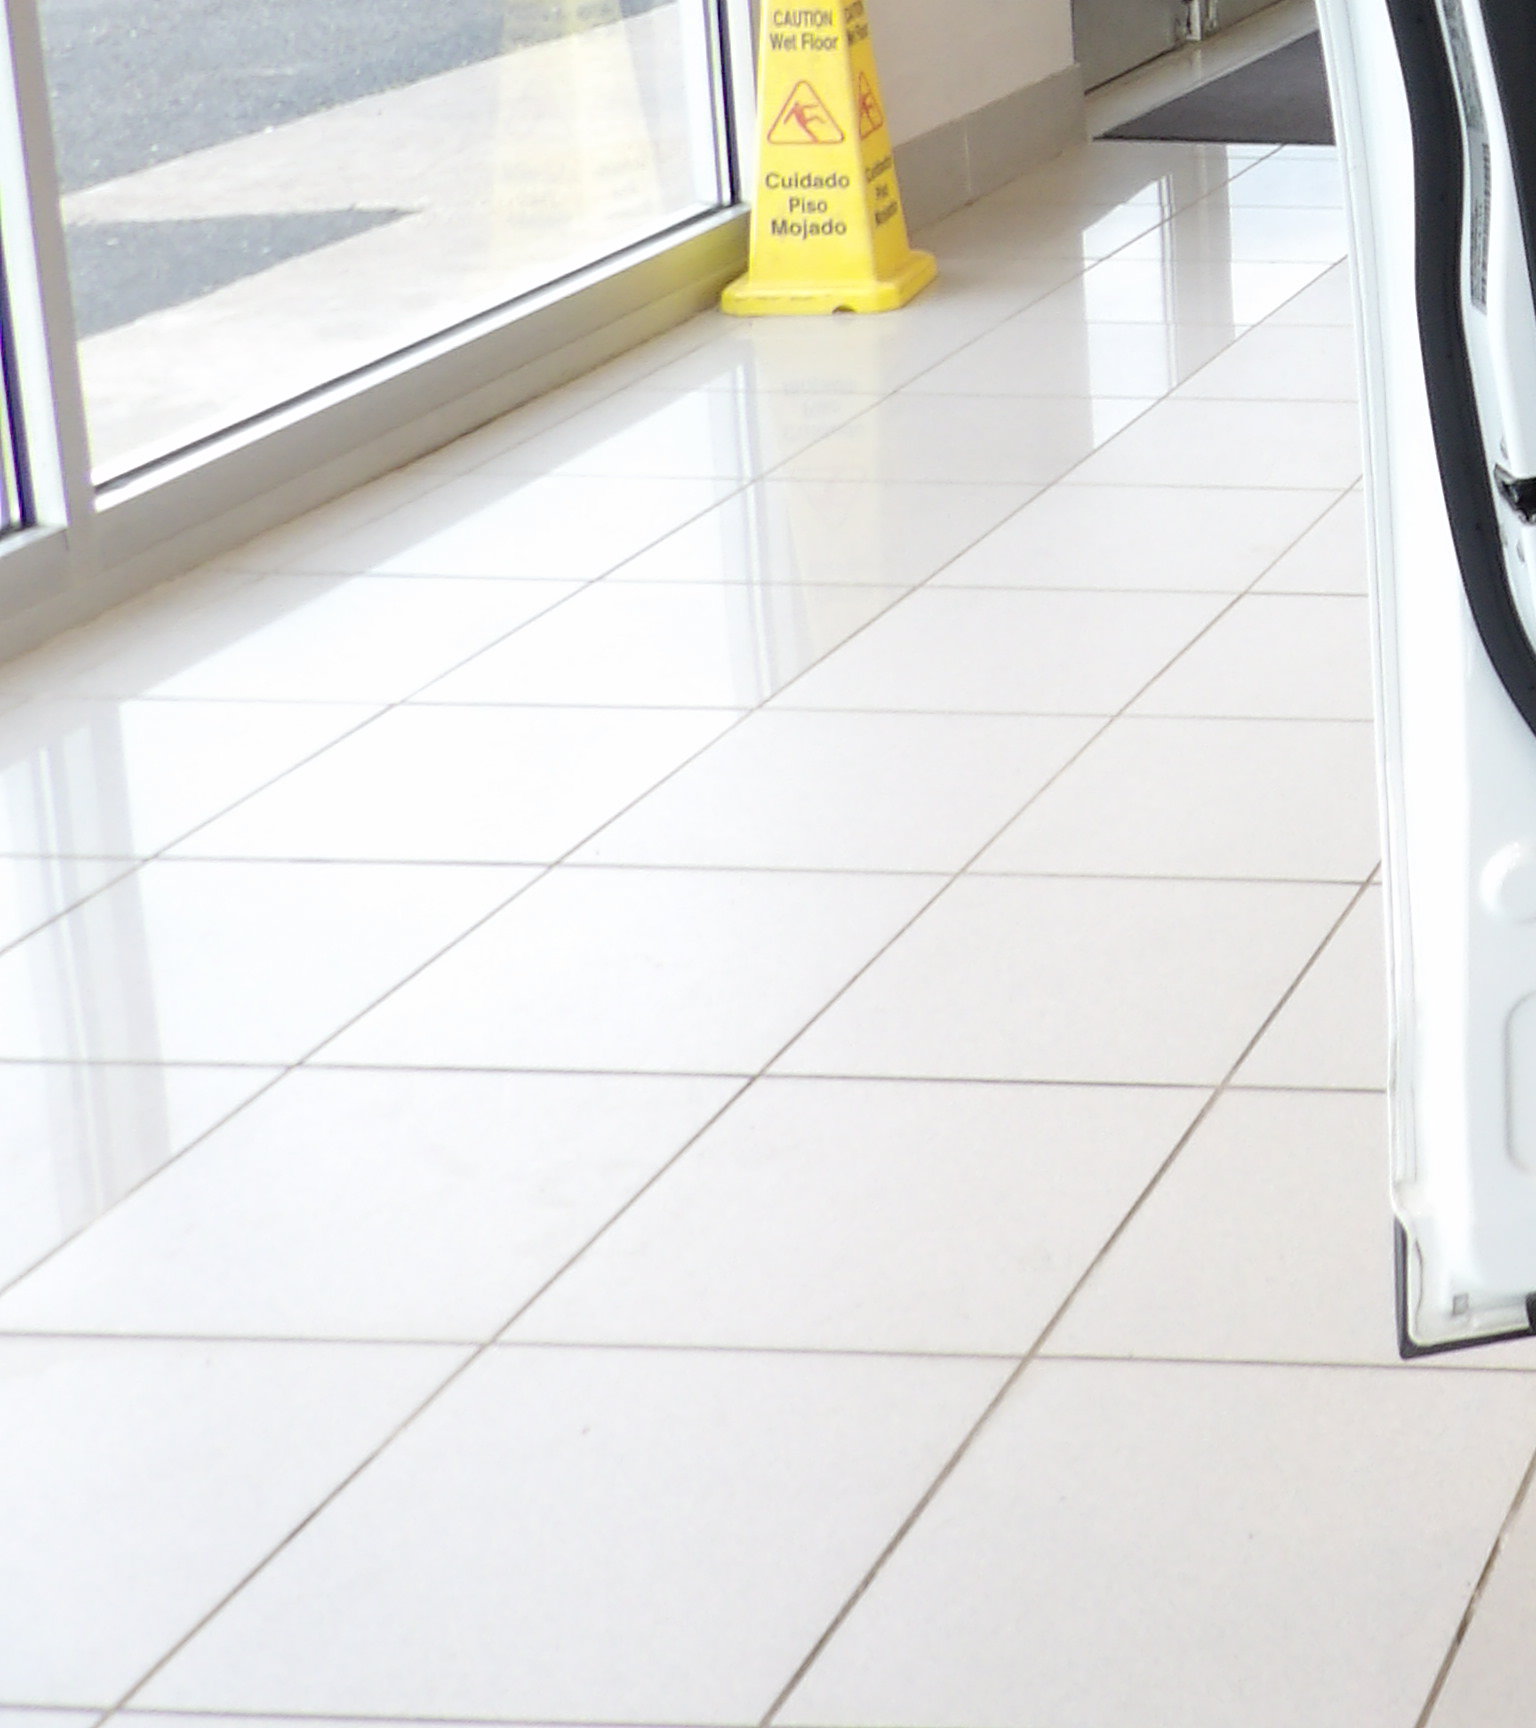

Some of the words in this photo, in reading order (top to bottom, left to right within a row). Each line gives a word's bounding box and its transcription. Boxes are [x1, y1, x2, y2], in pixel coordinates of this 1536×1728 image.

[773, 9, 833, 26] CAUTION
[769, 33, 797, 51] Wet
[801, 32, 838, 50] Floor
[765, 172, 850, 189] Cuidado
[789, 197, 828, 213] Piso
[771, 218, 847, 240] Mojado
